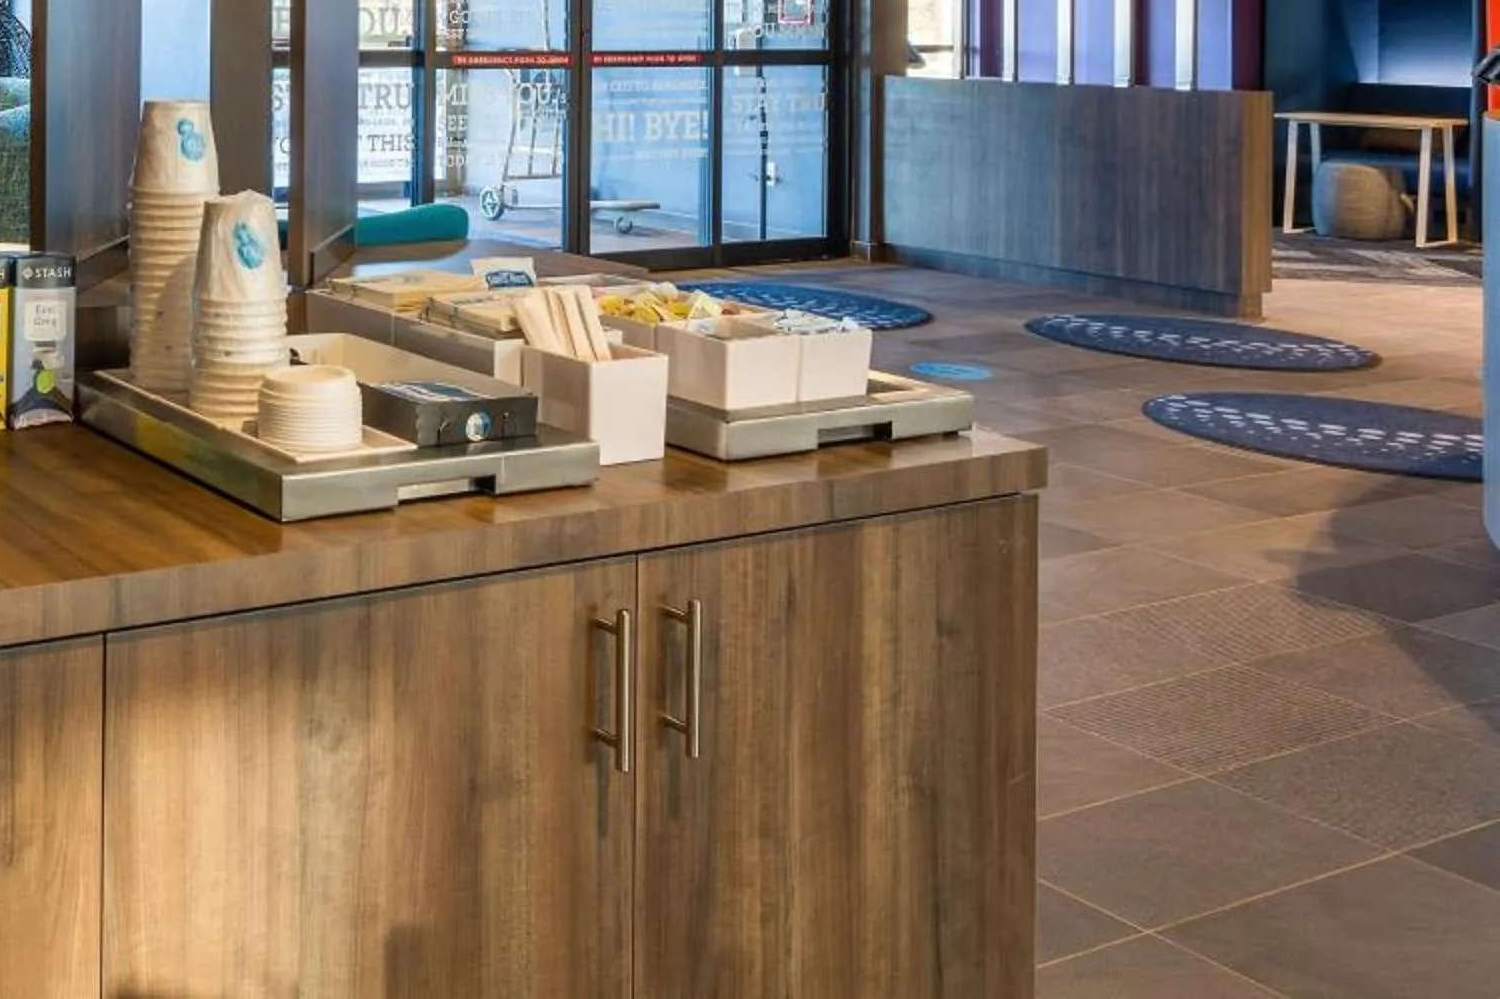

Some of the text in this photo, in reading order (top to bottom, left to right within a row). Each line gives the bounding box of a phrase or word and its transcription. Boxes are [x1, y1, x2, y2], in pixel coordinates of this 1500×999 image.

[596, 110, 709, 141] HI! BYE!
[368, 134, 415, 151] THIS
[34, 267, 72, 278] STASH
